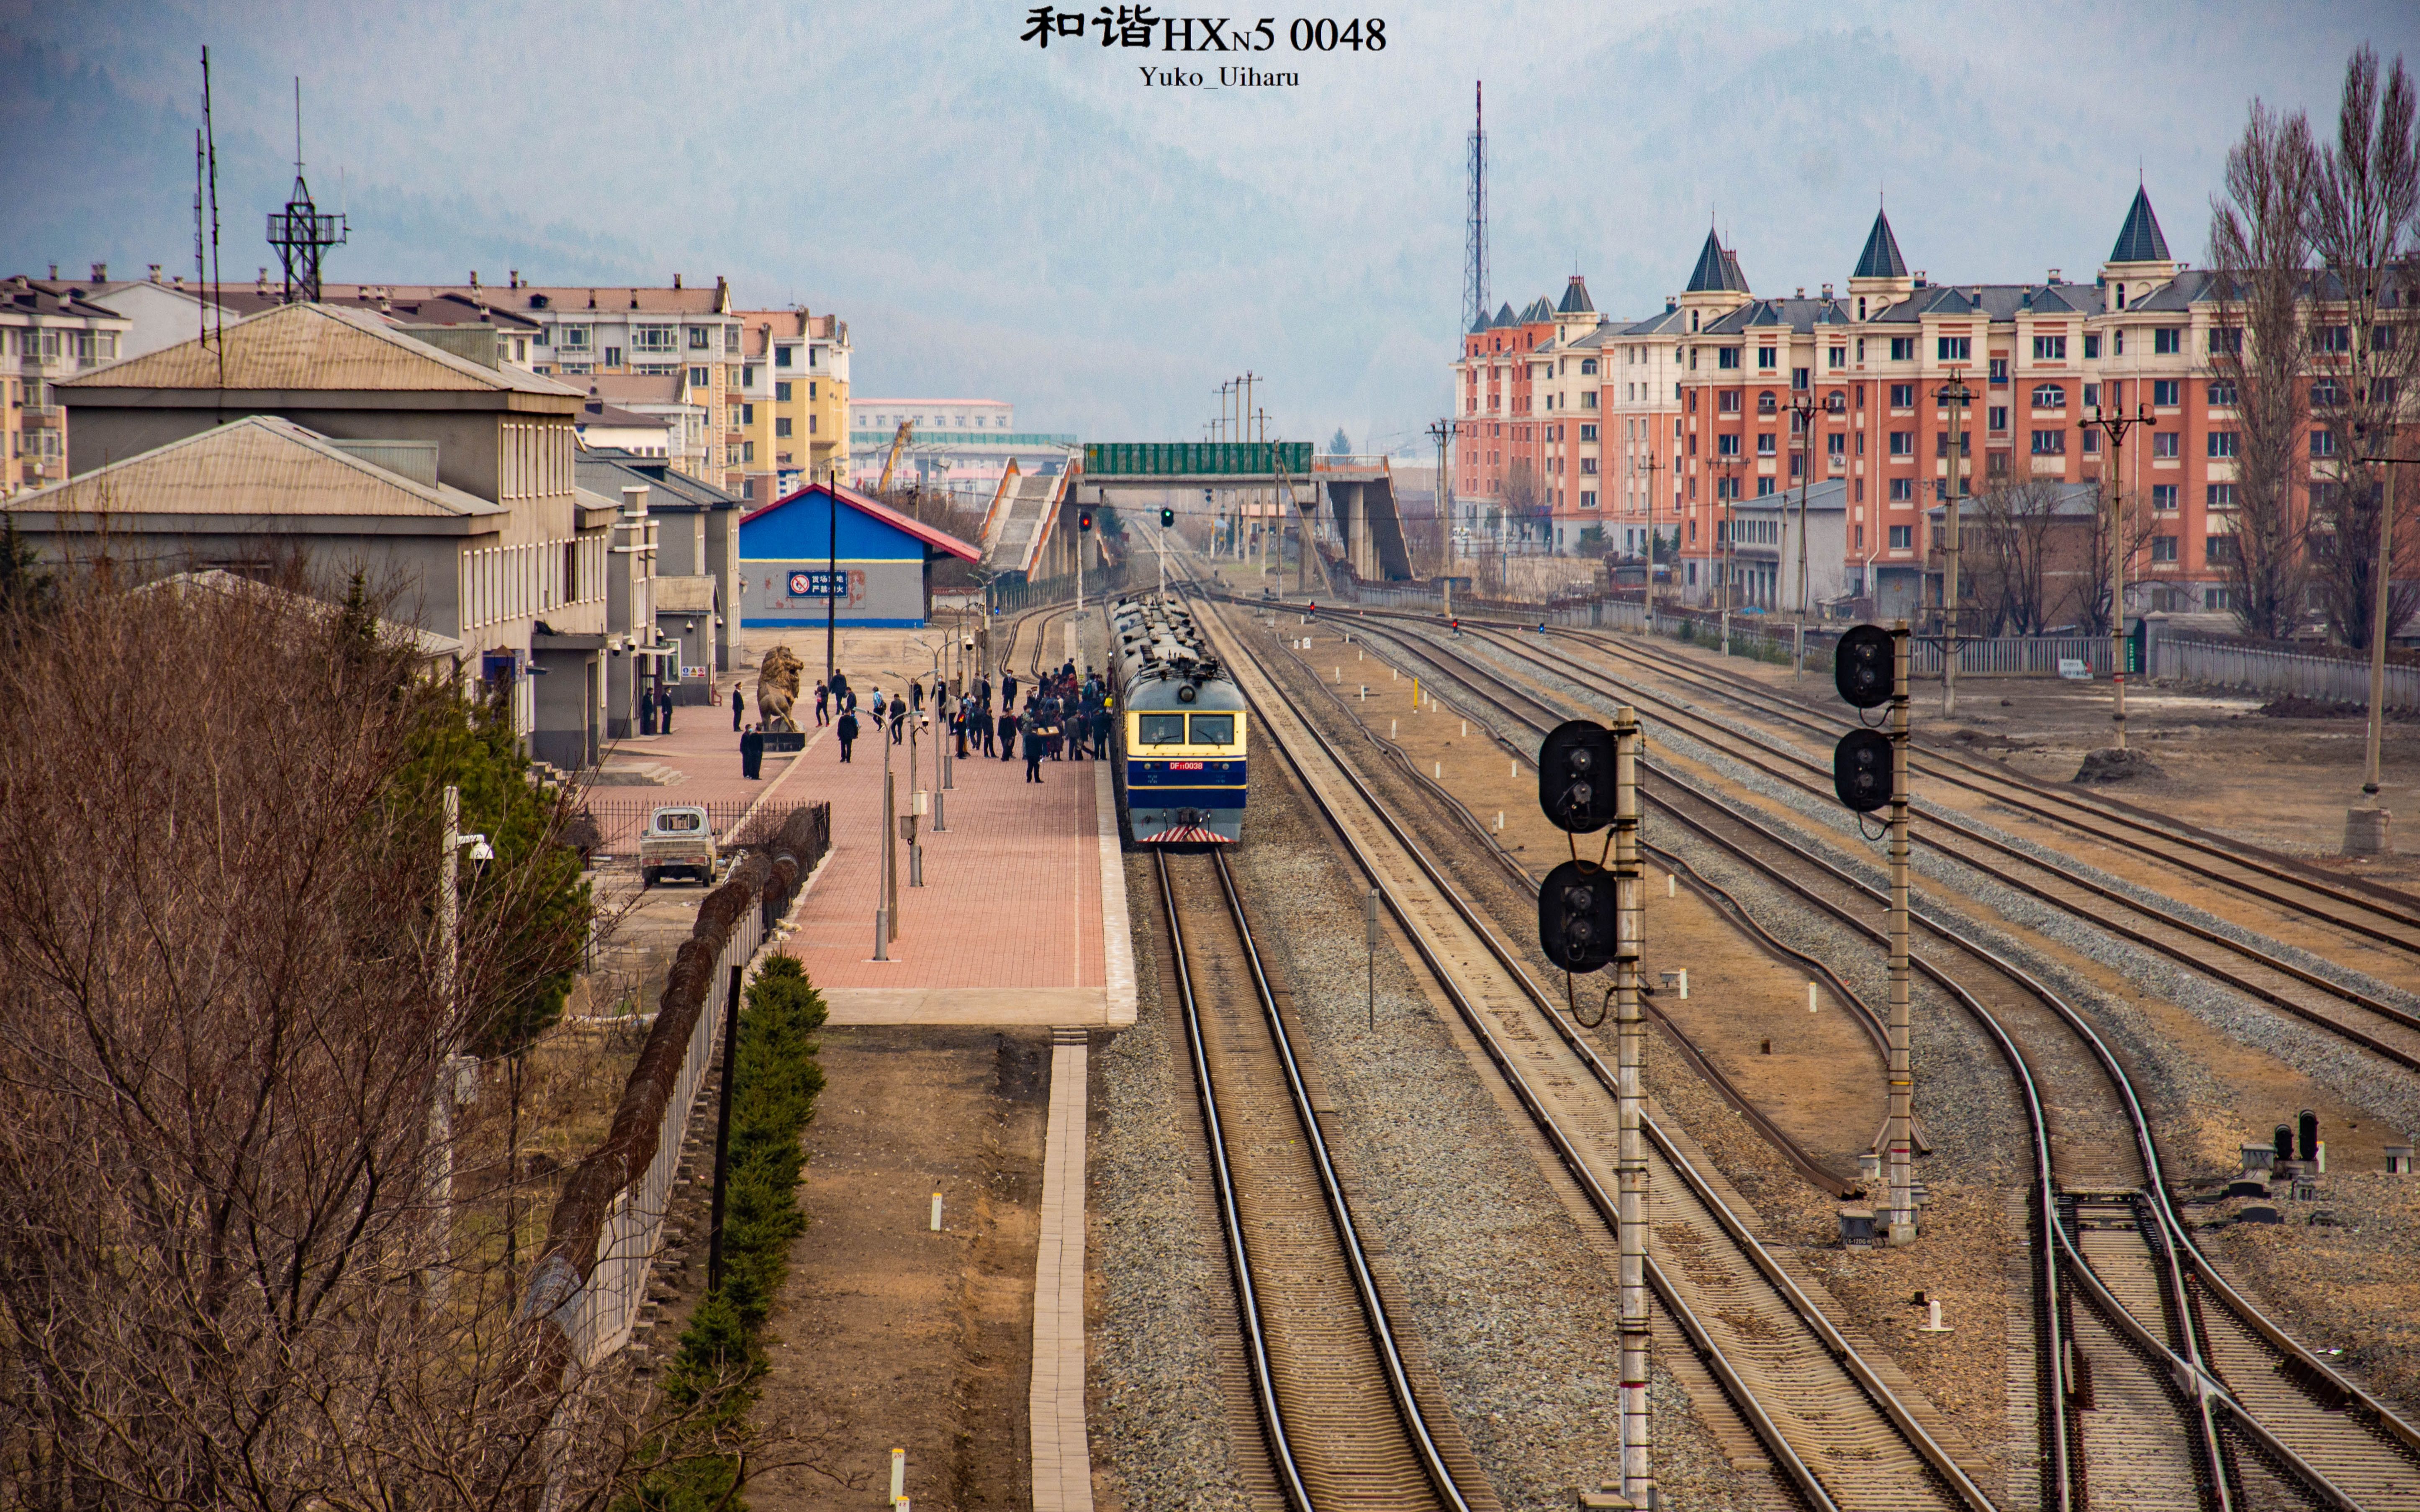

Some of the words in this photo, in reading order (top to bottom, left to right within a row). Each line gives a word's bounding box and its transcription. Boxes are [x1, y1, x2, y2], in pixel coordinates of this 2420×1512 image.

[812, 575, 844, 583] 货场地
[812, 585, 844, 593] 严禁火
